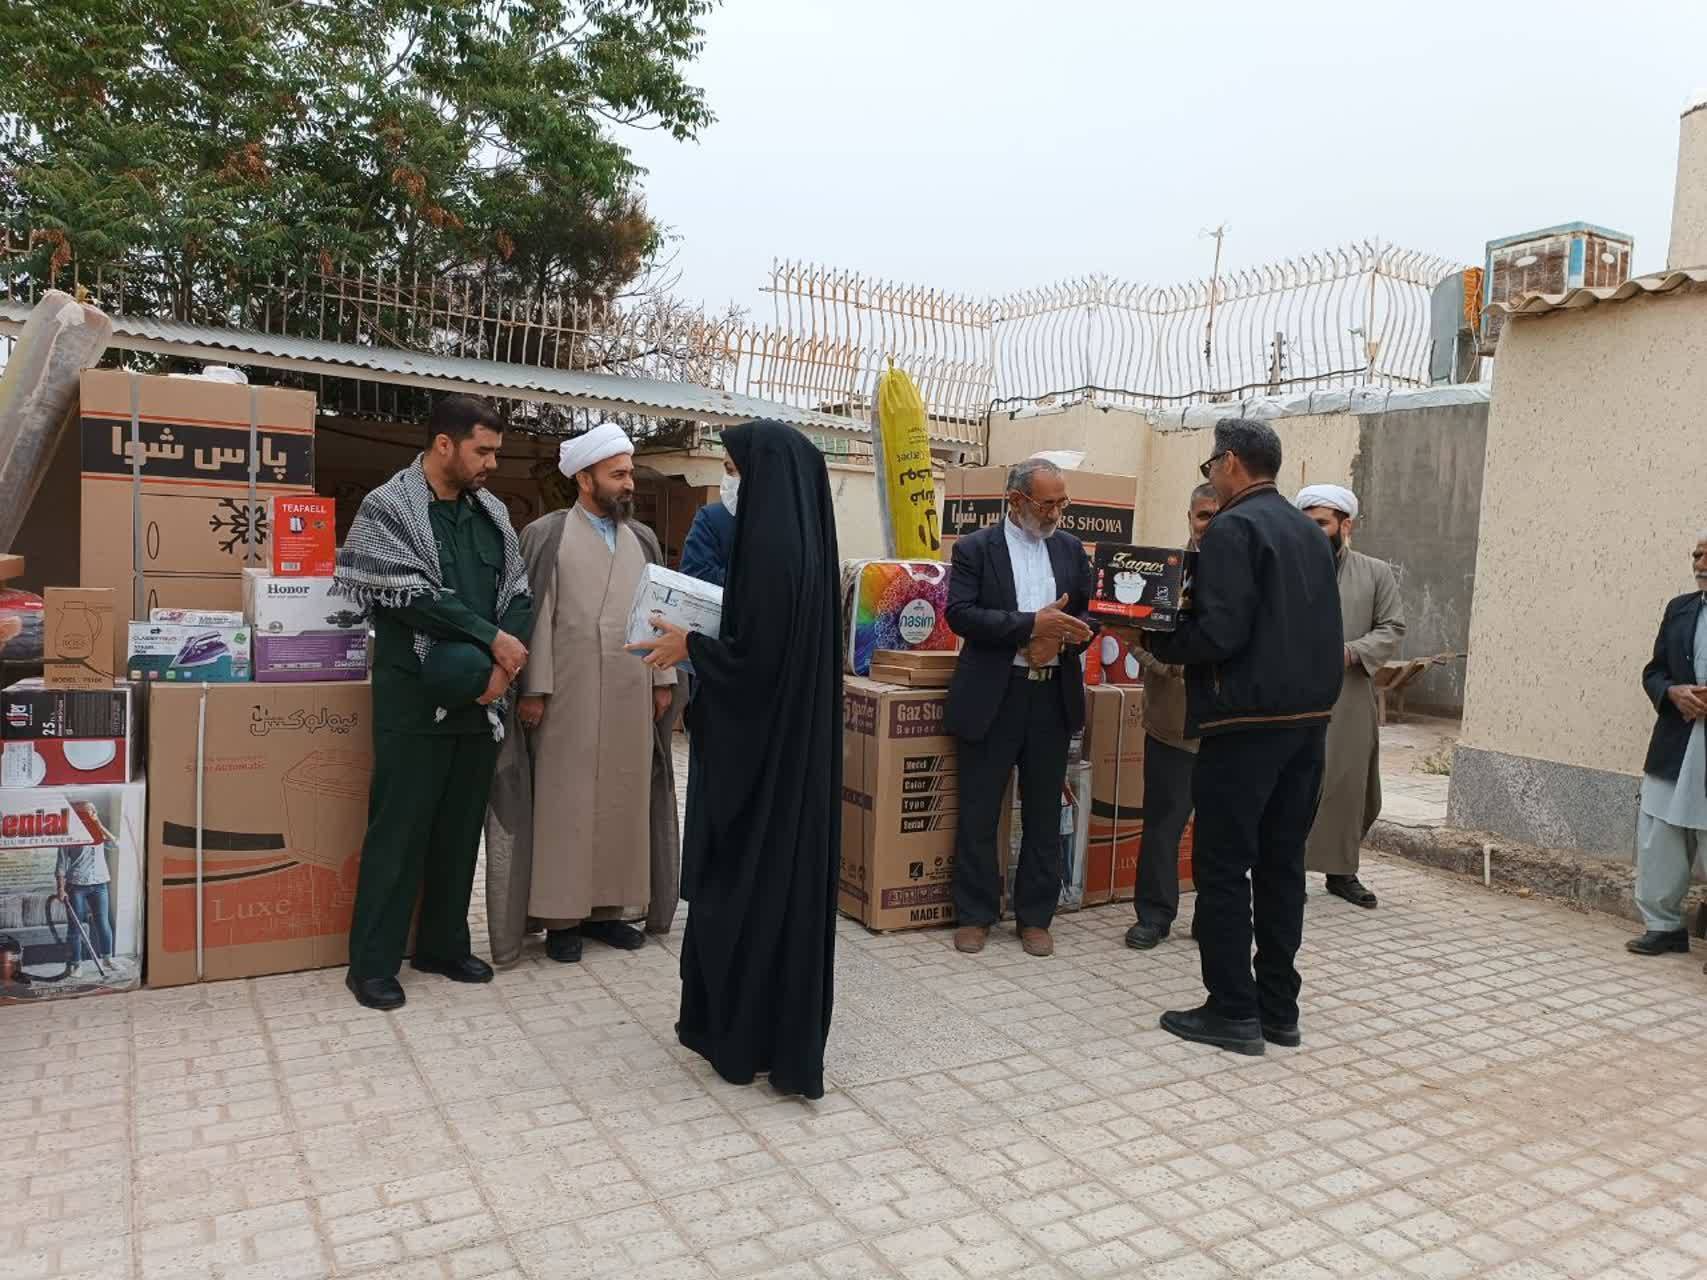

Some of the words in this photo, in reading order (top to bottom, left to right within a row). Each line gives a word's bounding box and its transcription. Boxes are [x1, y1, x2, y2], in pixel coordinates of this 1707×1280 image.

[194, 437, 287, 481] پارس
[1077, 516, 1123, 533] SHOWA
[267, 583, 310, 594] Honor
[897, 703, 921, 721] Gaz
[922, 702, 944, 721] Sto
[904, 780, 926, 790] Color
[904, 800, 925, 810] Type
[0, 808, 69, 838] enial
[903, 820, 924, 830] Serial
[211, 897, 291, 922] Luxe
[910, 907, 939, 921] MADE
